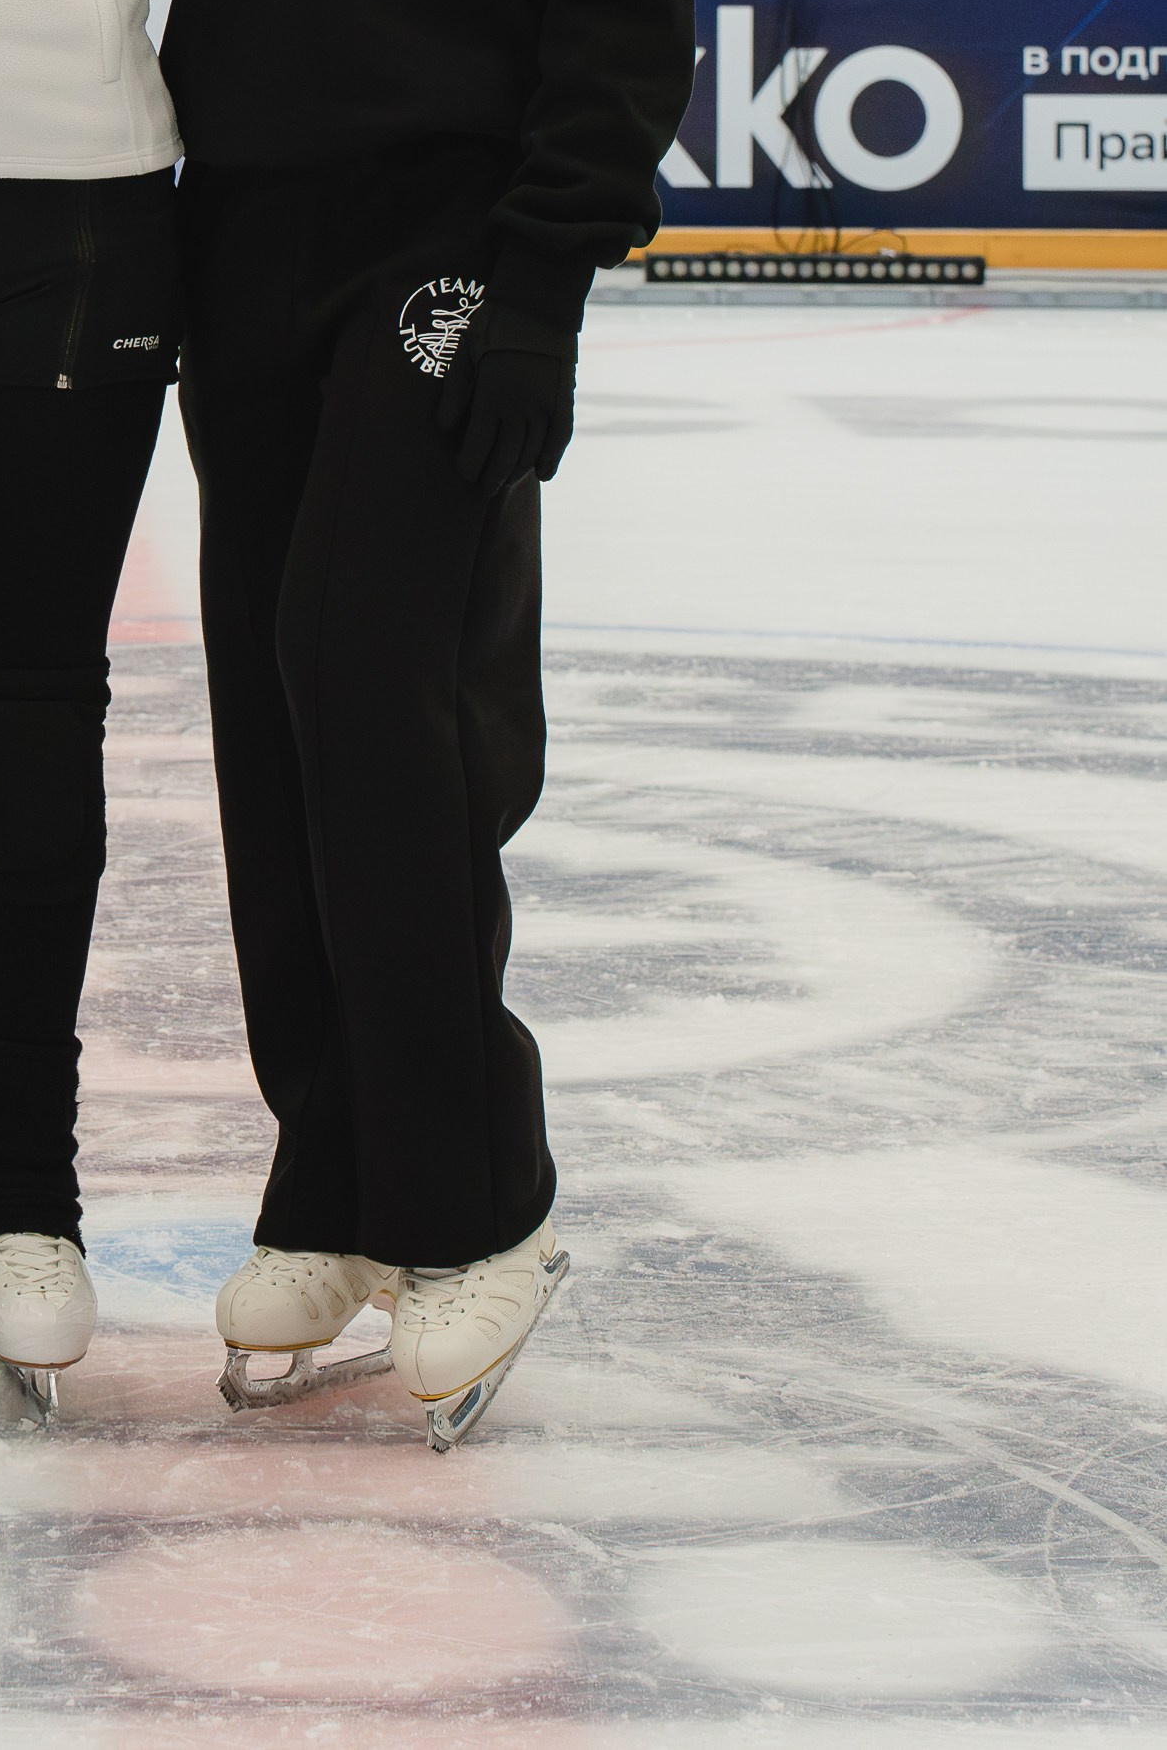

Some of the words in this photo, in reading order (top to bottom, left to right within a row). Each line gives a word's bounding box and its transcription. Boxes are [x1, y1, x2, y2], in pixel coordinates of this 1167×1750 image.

[1023, 46, 1050, 75] в
[423, 277, 485, 300] TEAM
[113, 335, 160, 350] CHERSA
